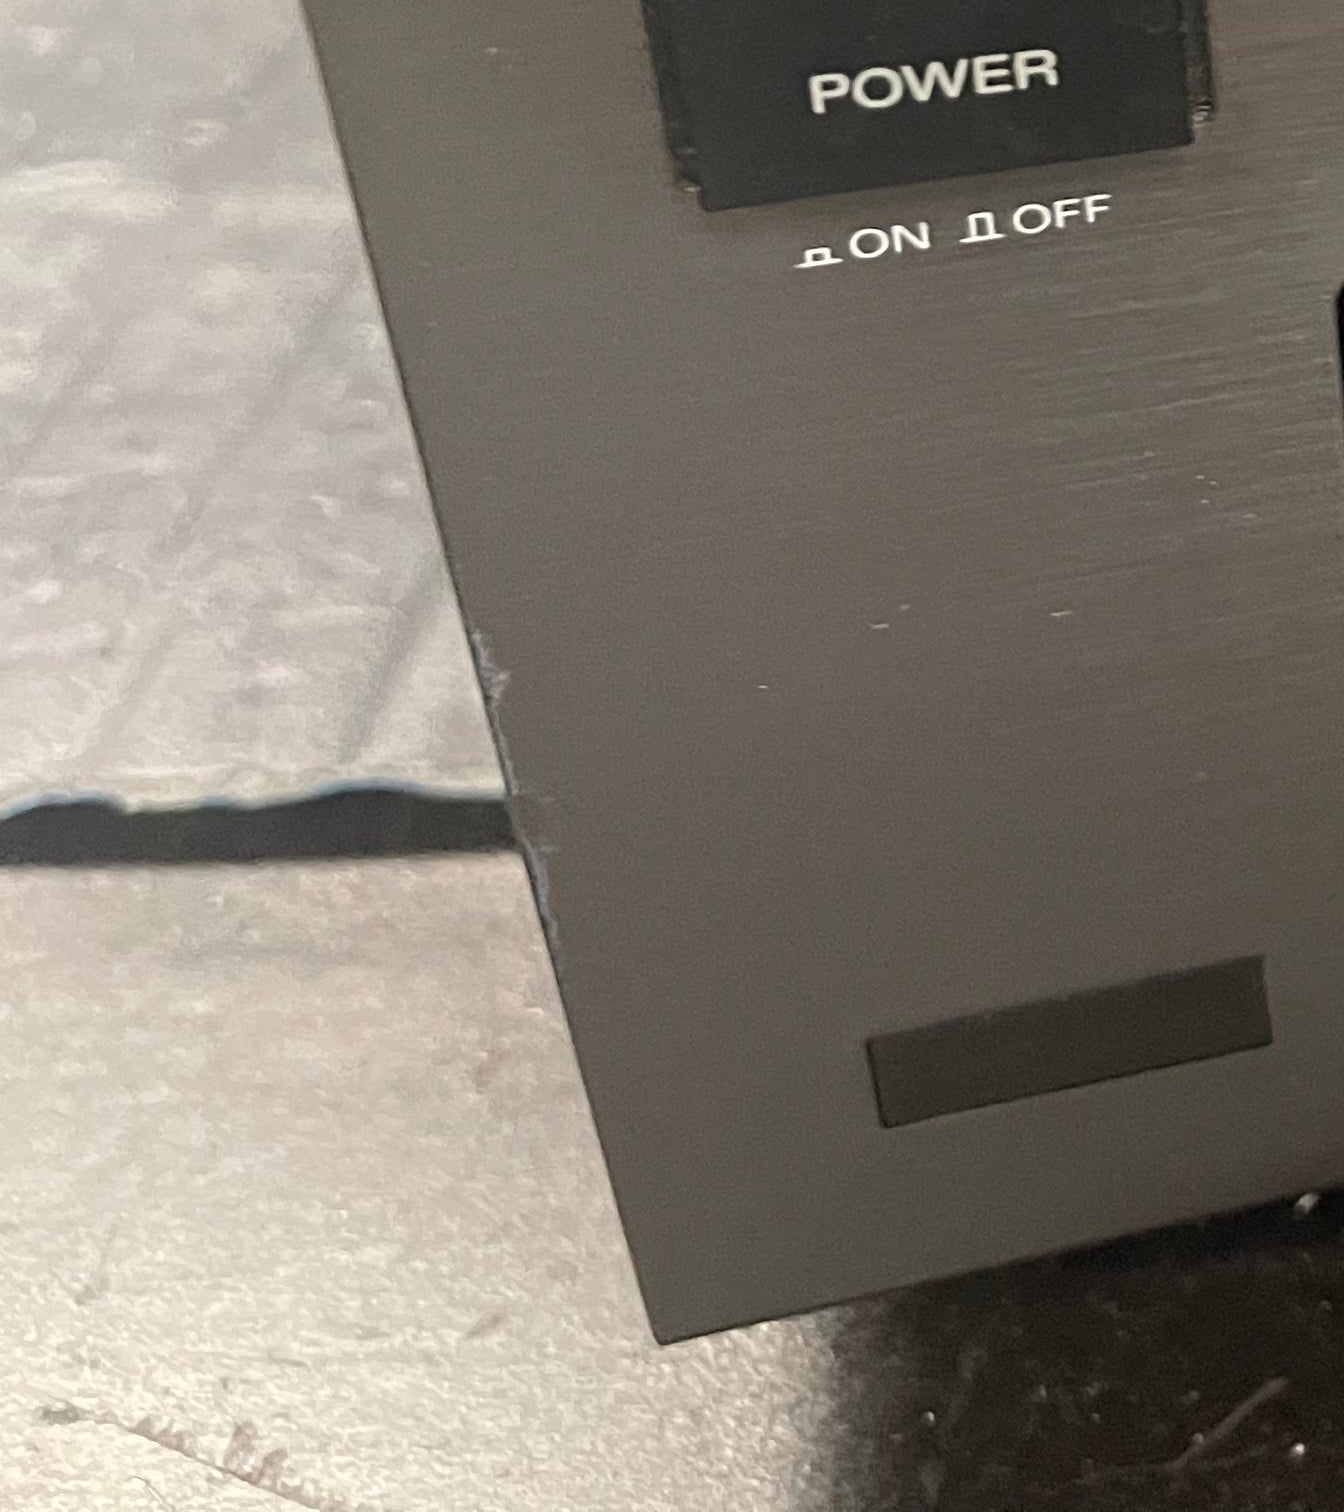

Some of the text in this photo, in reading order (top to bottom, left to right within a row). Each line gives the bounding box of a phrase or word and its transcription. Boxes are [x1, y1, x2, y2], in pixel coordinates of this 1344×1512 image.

[808, 48, 1059, 115] POWER
[848, 193, 1112, 260] ON OFF
